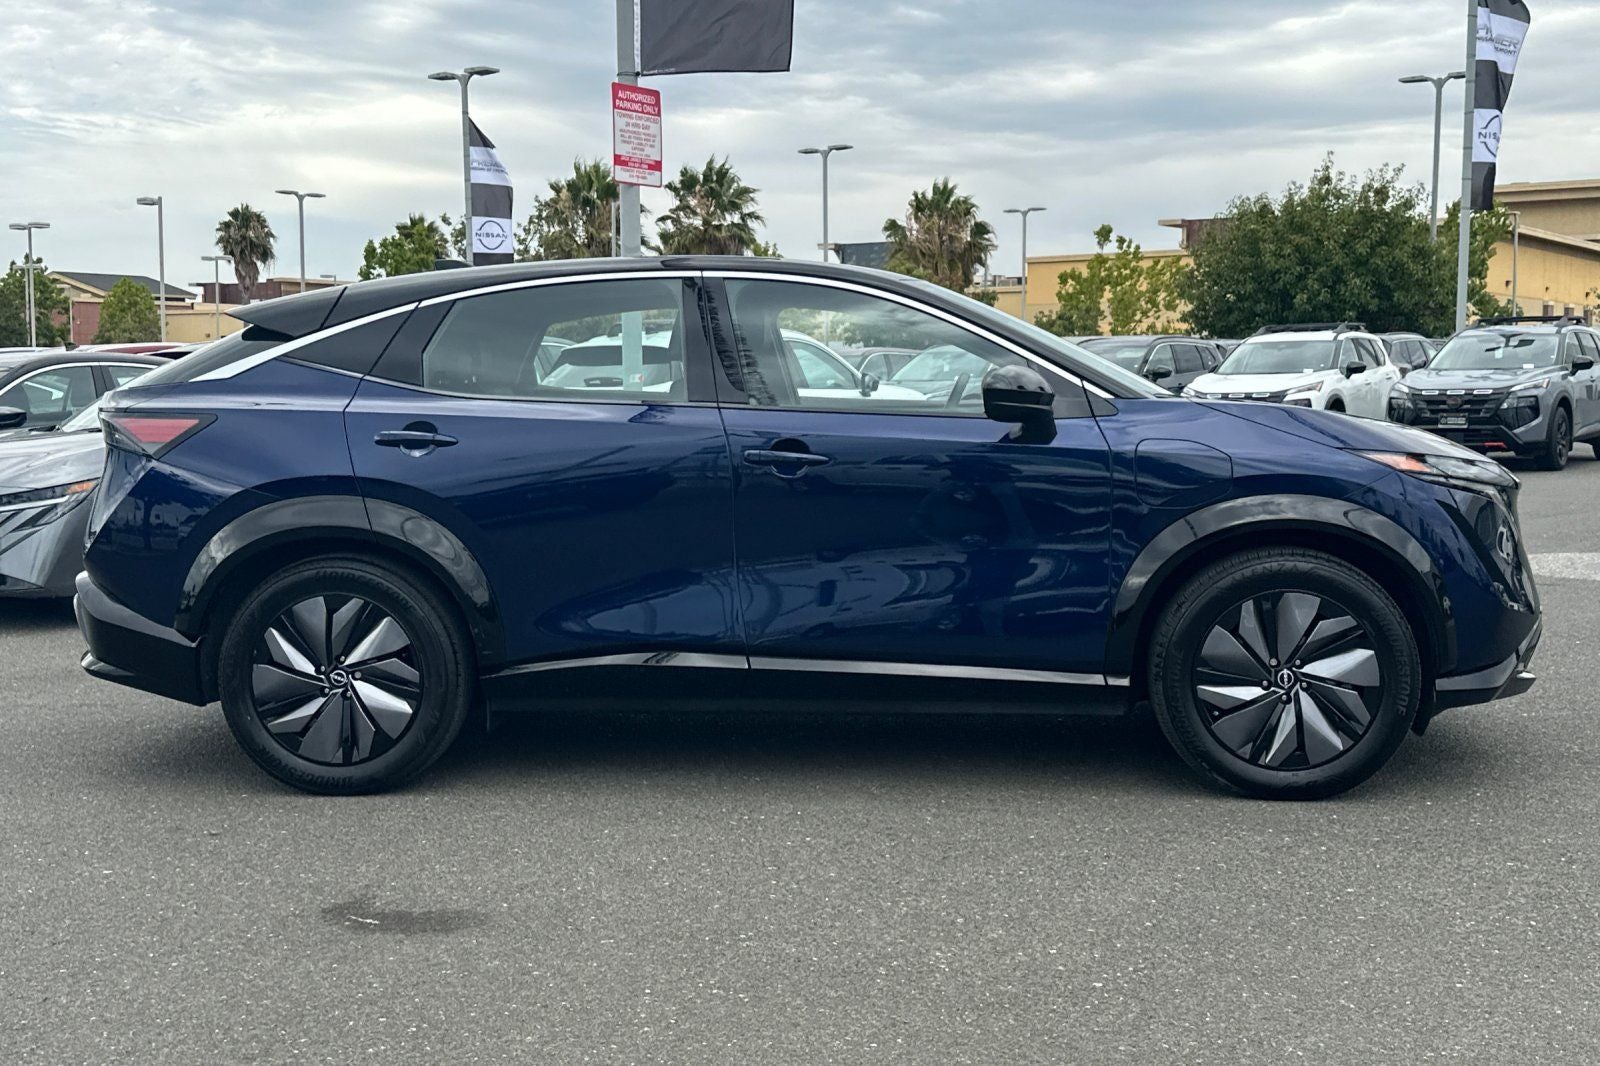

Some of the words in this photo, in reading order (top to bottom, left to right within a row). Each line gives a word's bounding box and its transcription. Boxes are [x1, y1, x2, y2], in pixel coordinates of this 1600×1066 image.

[617, 90, 655, 104] AUTHORIZED
[615, 99, 642, 112] PARKING
[643, 105, 659, 116] ONLY
[616, 111, 635, 120] TOWING
[635, 115, 660, 125] ENFORCED
[475, 231, 508, 240] NISSAN
